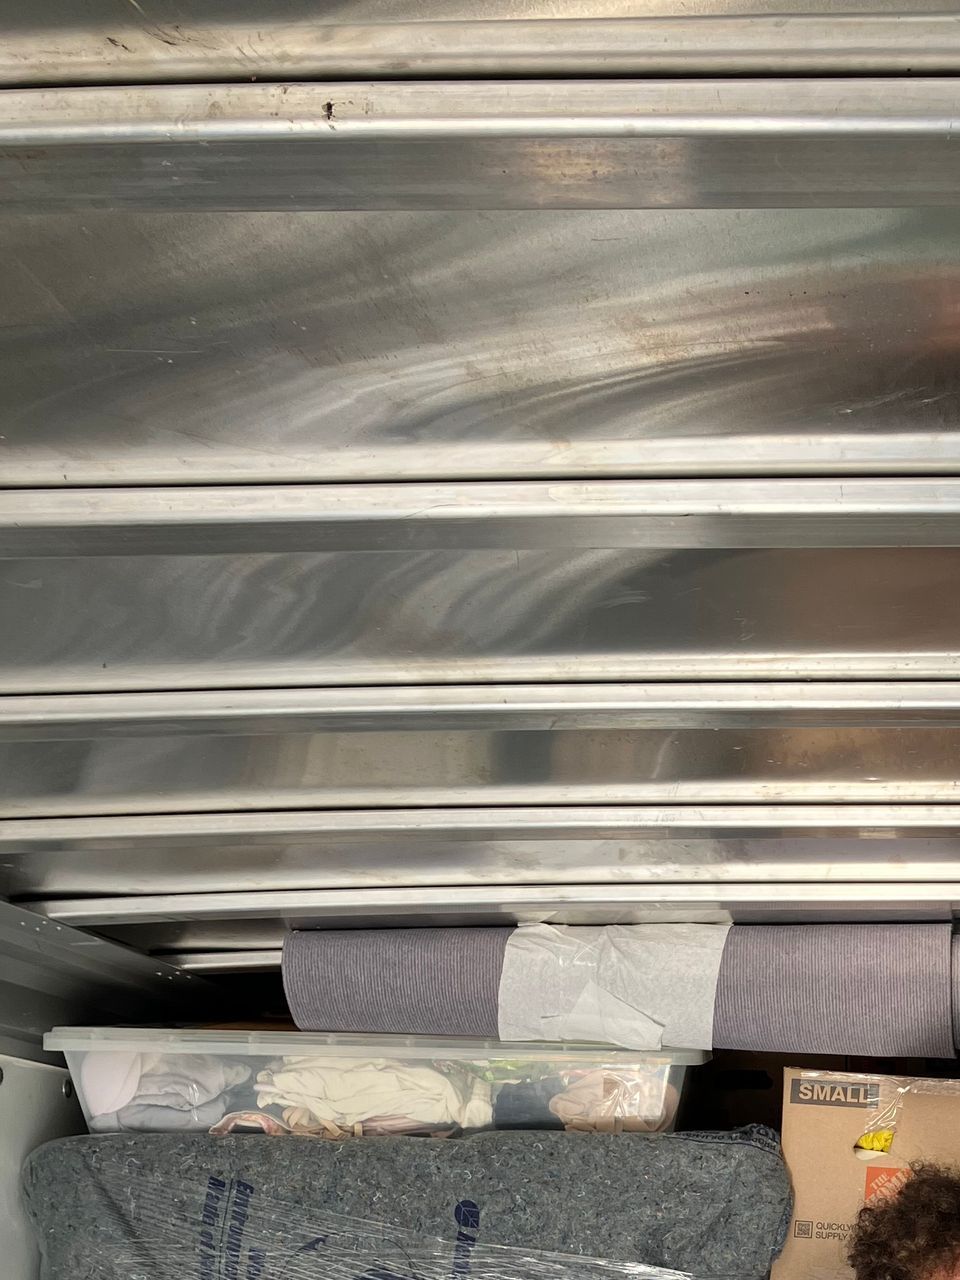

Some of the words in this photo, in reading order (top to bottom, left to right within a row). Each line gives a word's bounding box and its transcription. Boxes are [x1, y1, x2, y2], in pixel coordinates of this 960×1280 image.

[798, 1084, 869, 1104] SMALL
[870, 1171, 890, 1191] THE
[816, 1222, 852, 1232] QUICKLY
[815, 1231, 848, 1240] SUPPLY
